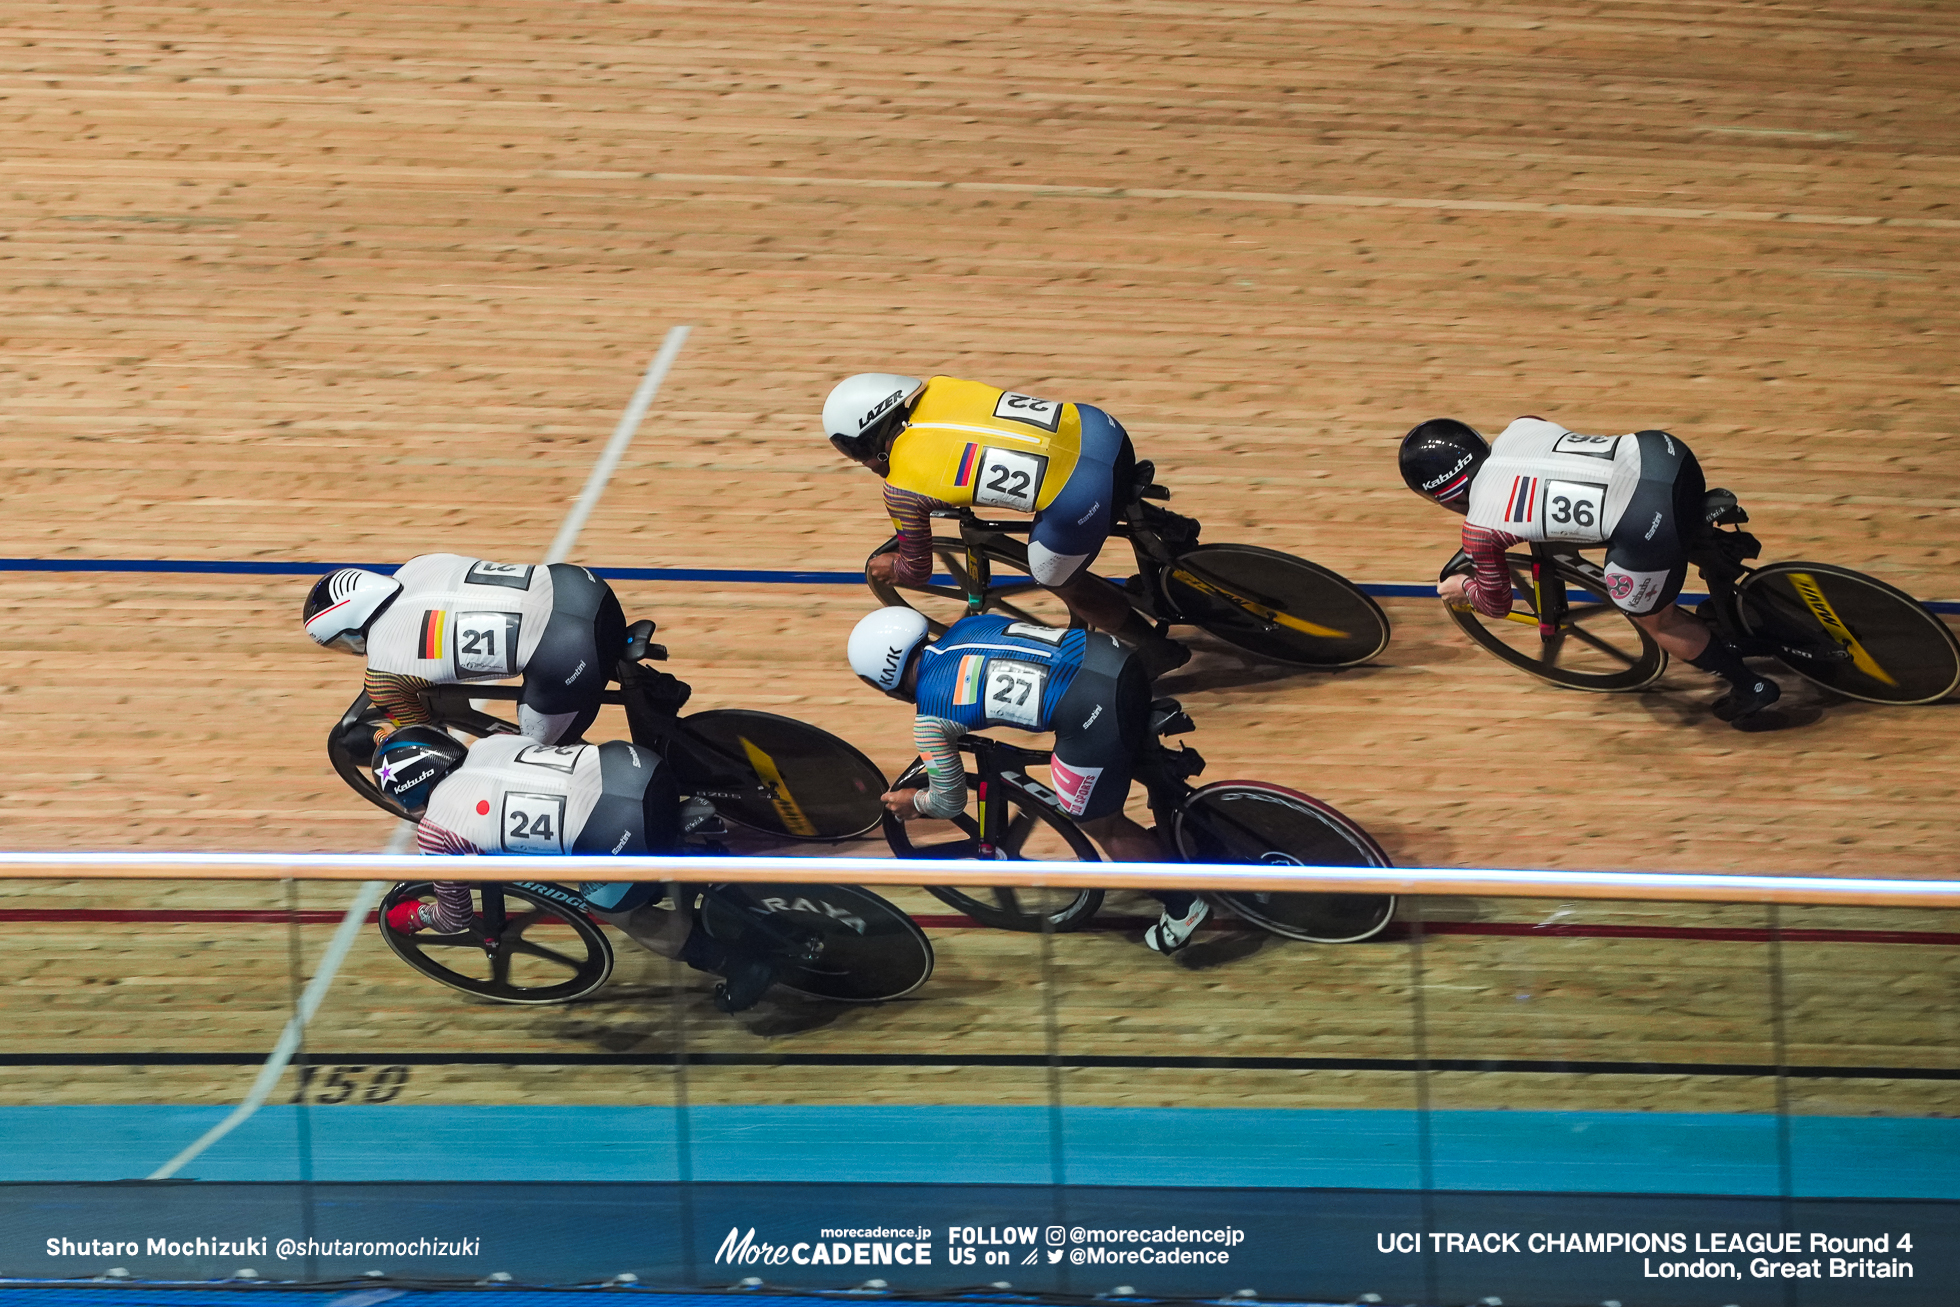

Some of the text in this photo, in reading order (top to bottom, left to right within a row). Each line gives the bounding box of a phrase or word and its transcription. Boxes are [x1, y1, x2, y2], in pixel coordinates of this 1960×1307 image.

[859, 389, 904, 430] LAZER
[986, 464, 1031, 499] 22
[1422, 453, 1473, 490] Kabuto
[1078, 501, 1100, 525] Santini
[1551, 495, 1595, 527] 36
[1644, 511, 1663, 541] Santini
[1628, 577, 1652, 608] Kabuto
[461, 629, 495, 656] 21
[565, 659, 587, 686] Santini
[879, 645, 903, 686] KASK
[992, 674, 1033, 707] 27
[1082, 703, 1103, 730] Santini
[393, 768, 435, 795] Kabuto
[1074, 774, 1096, 805] SPORTS
[509, 810, 554, 841] 24
[611, 829, 632, 856] Santini
[290, 1065, 411, 1104] 150
